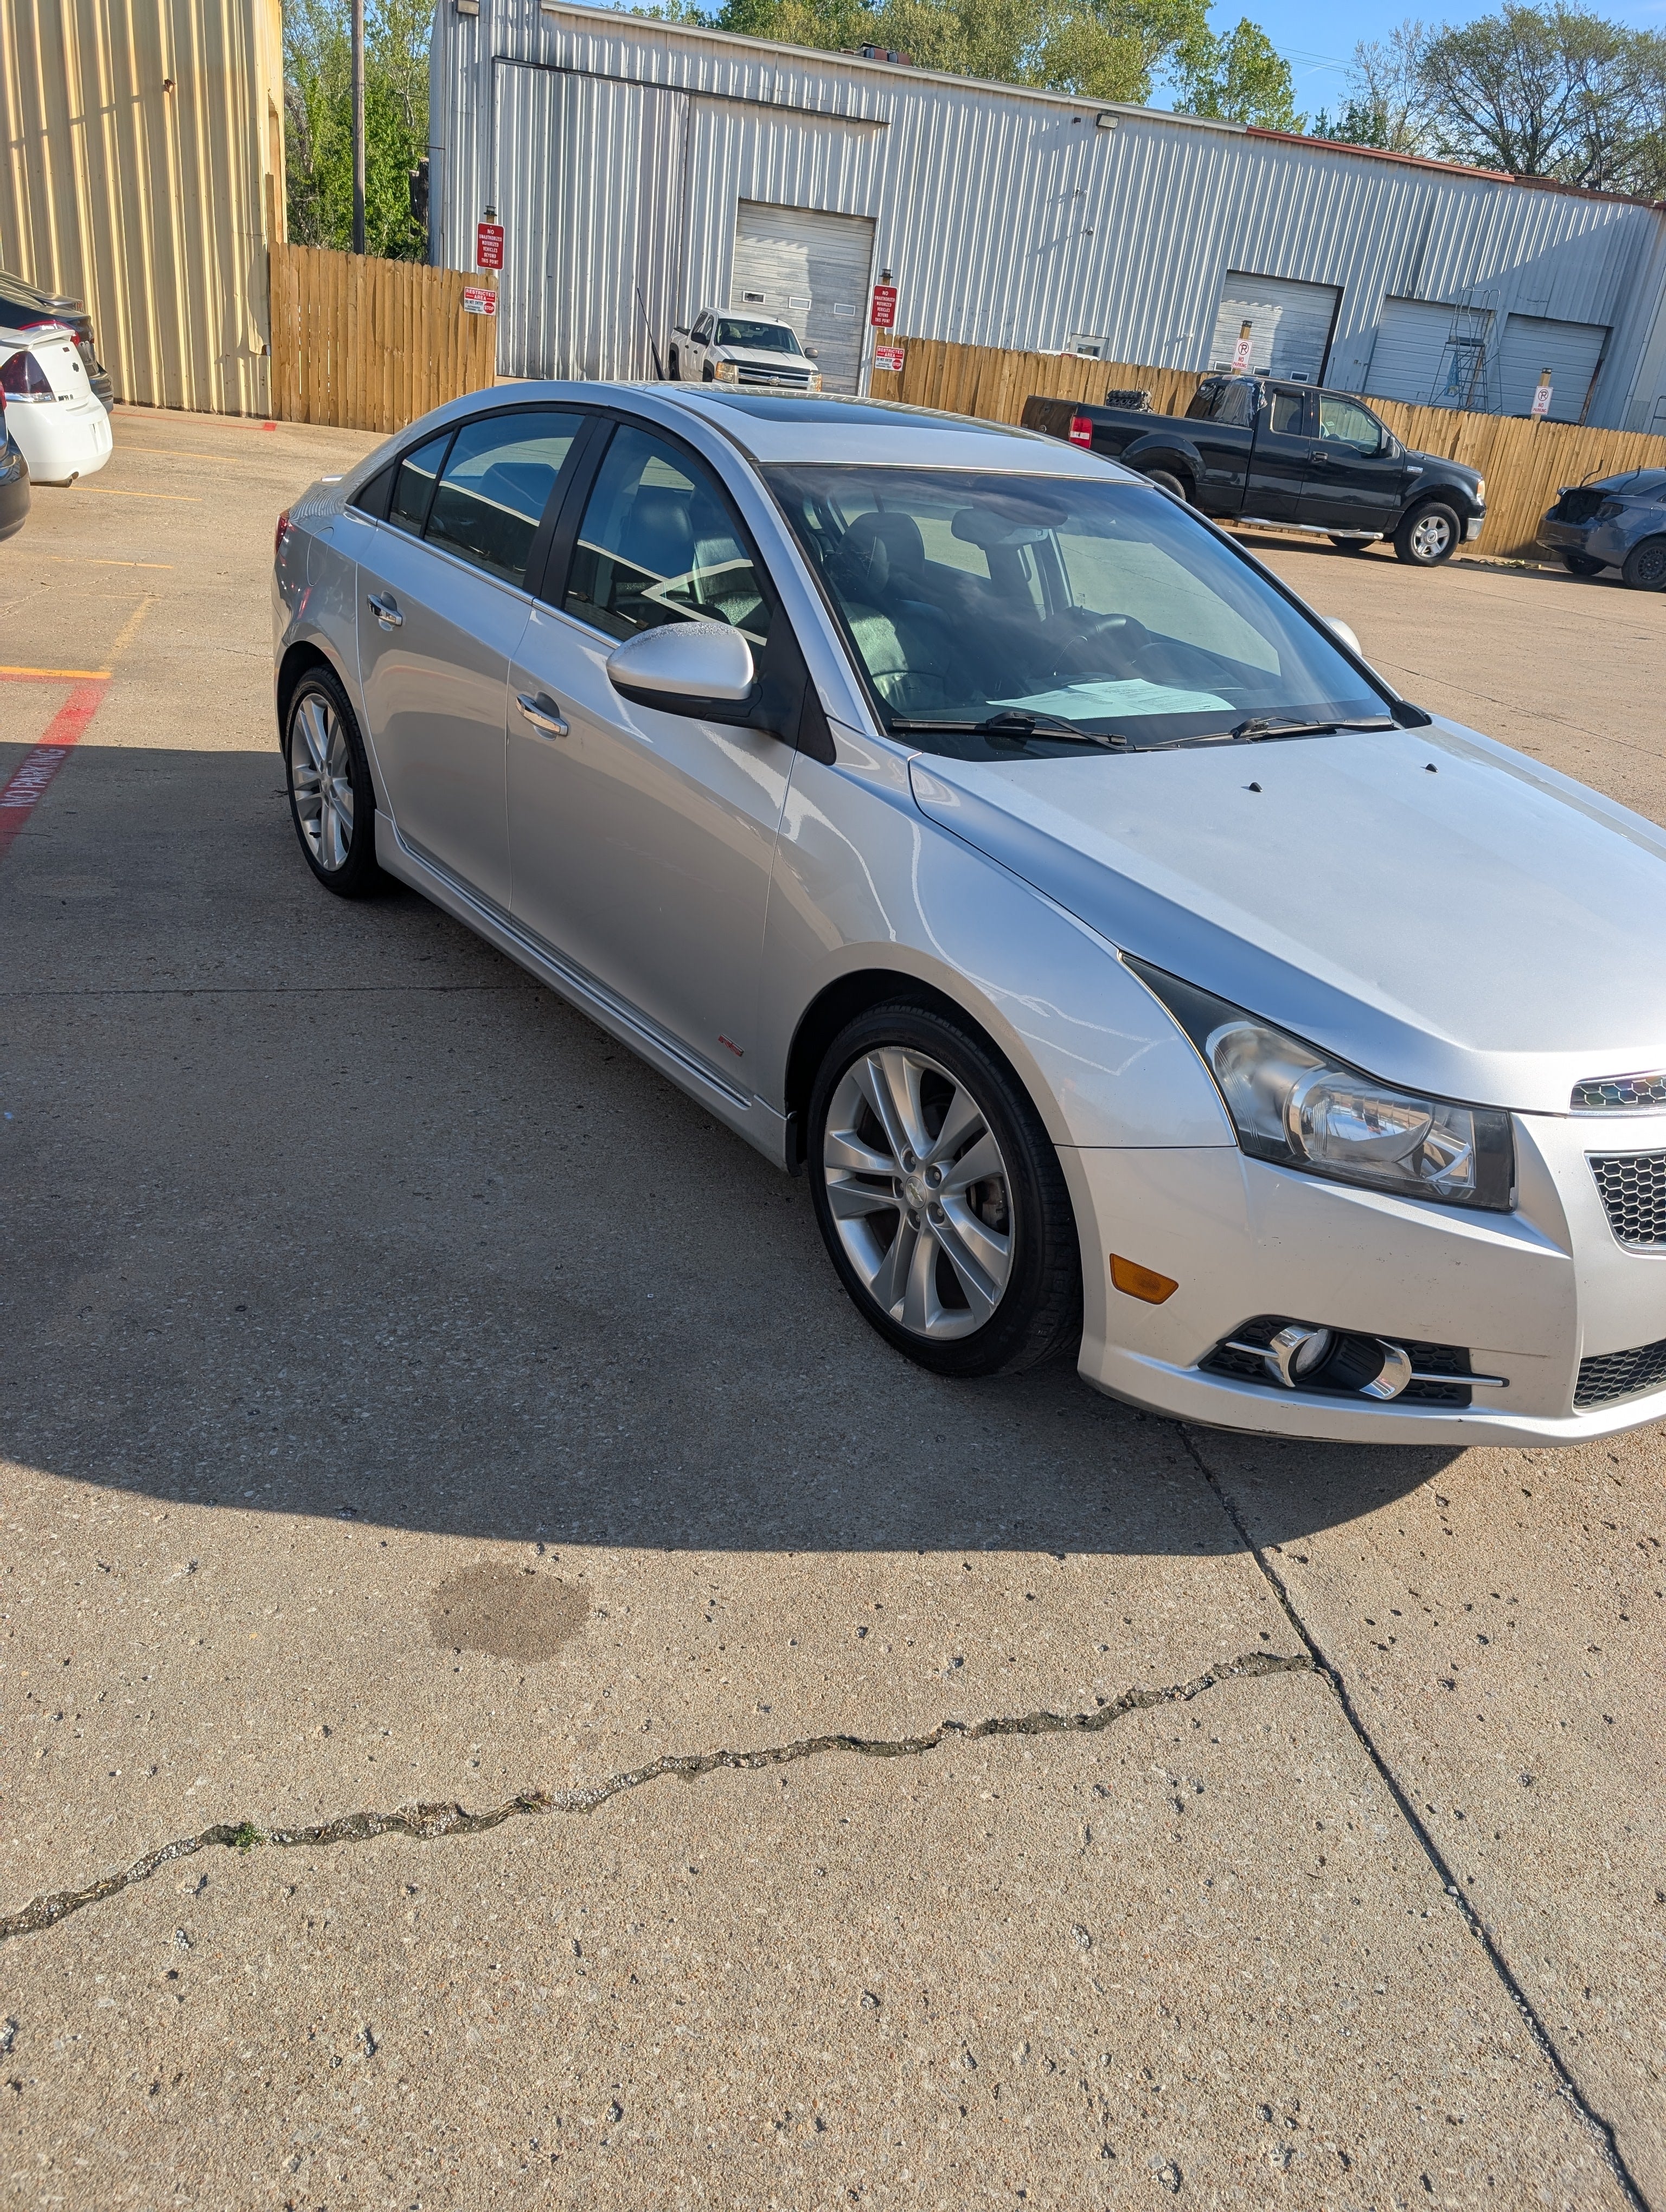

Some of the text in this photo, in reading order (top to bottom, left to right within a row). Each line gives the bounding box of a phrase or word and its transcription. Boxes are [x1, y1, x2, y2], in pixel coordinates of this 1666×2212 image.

[466, 289, 495, 297] RESTRICTED
[0, 749, 66, 807] NO PARKING
